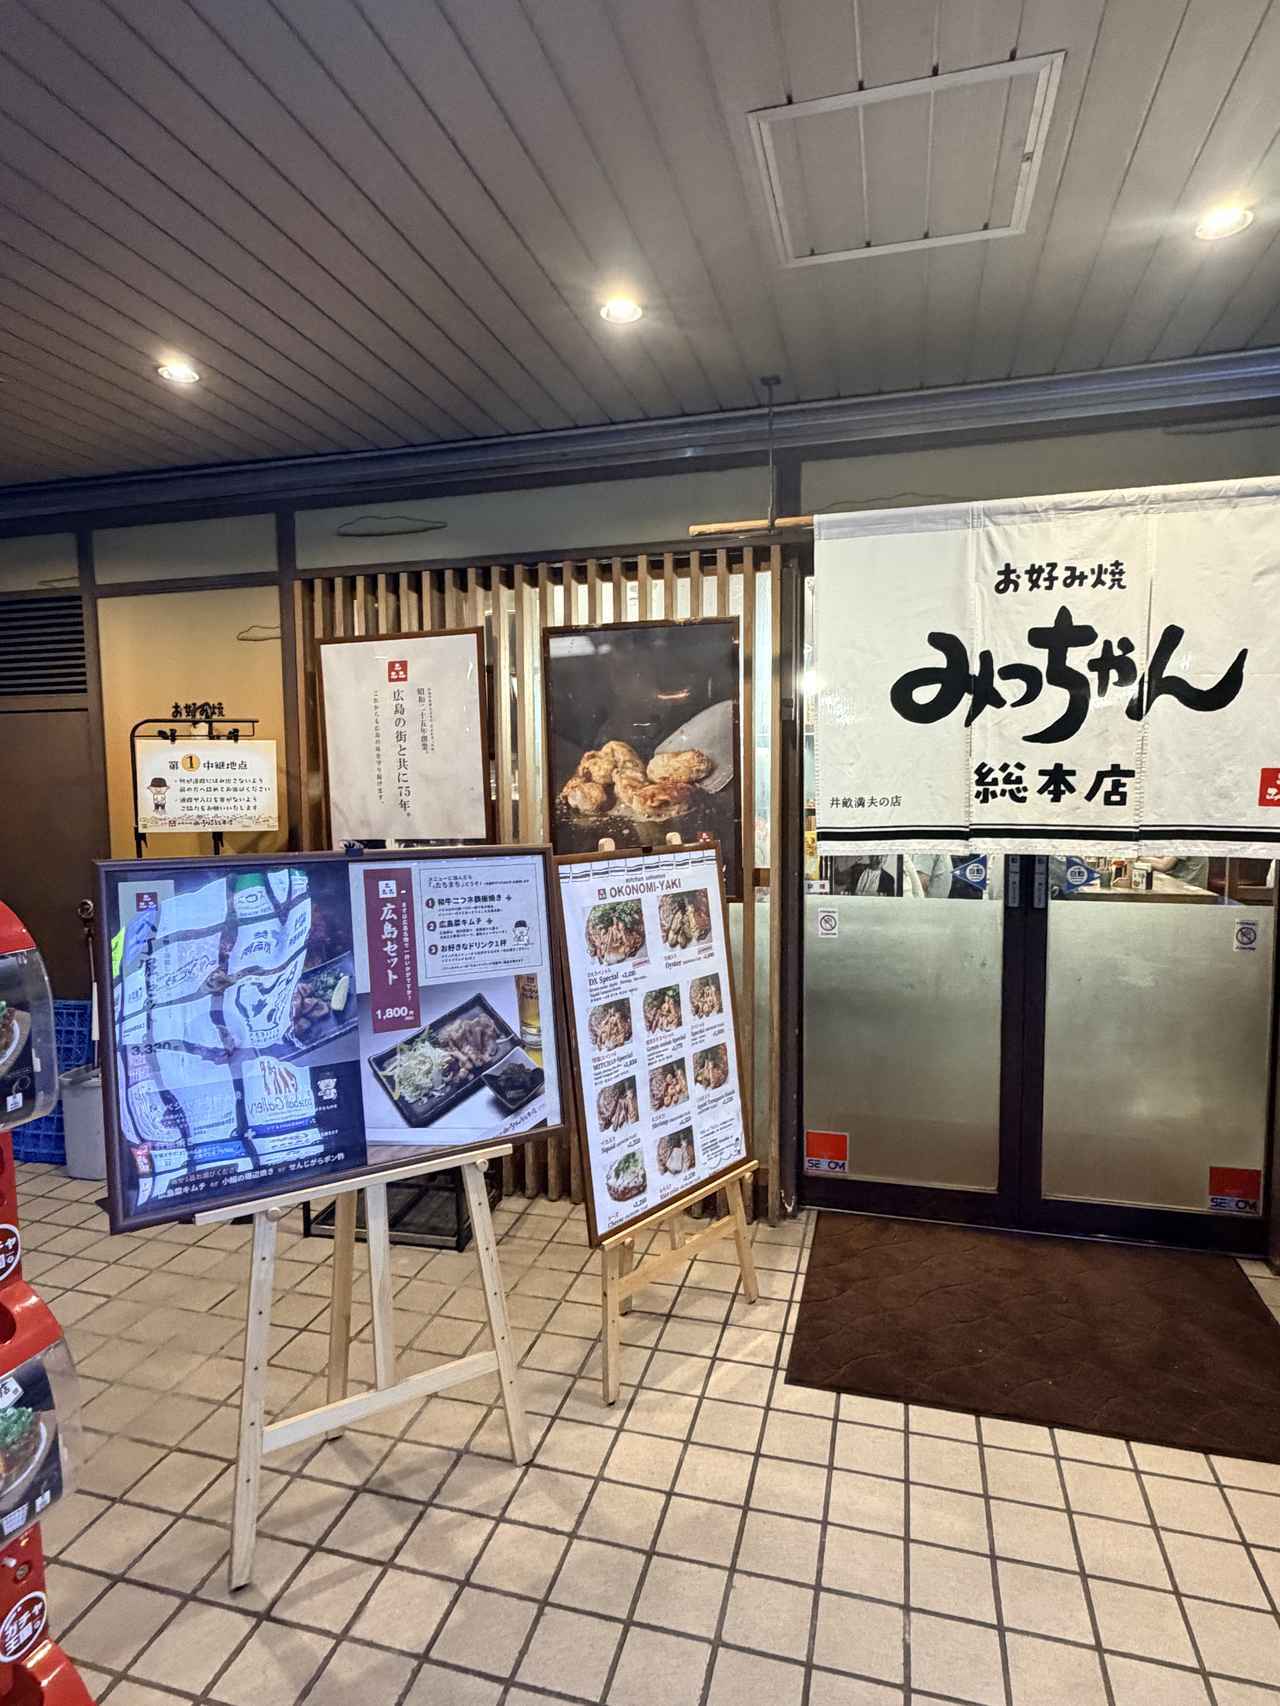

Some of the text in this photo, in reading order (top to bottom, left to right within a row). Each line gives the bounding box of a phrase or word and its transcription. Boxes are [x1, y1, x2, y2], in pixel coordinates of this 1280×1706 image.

[994, 560, 1127, 594] お好み焼
[890, 606, 1248, 744] みっちゃん
[974, 762, 1135, 806] 総本店
[609, 878, 681, 898] OKONOMI-YAKI
[380, 903, 399, 985] 広島セット
[1210, 1197, 1258, 1212] SEOM
